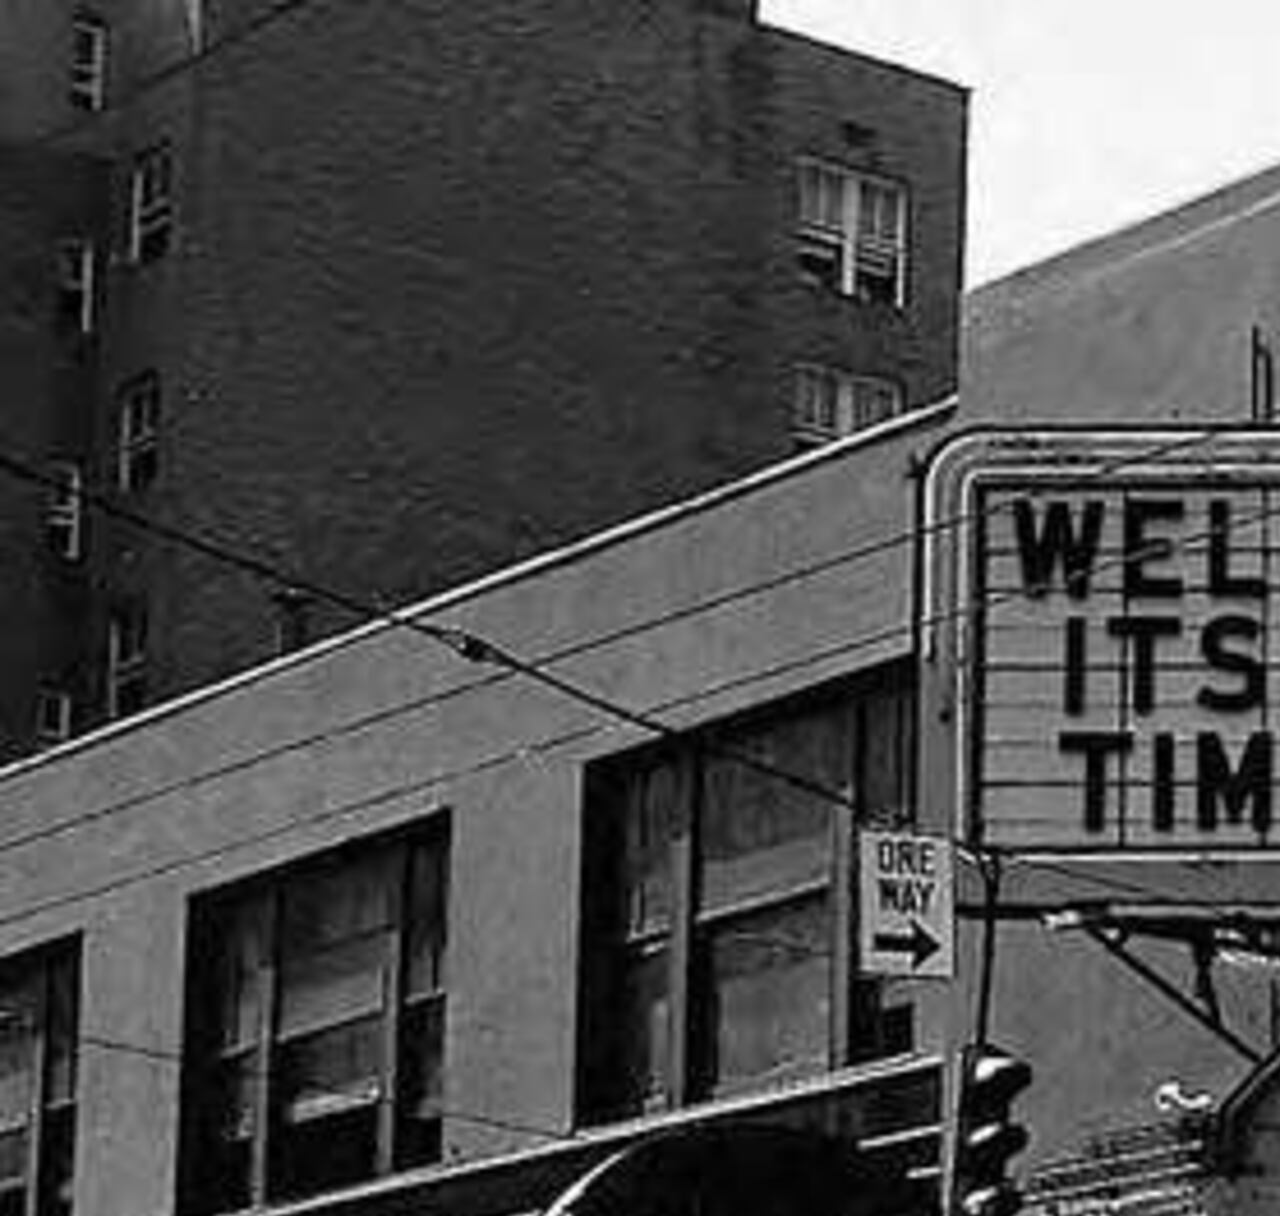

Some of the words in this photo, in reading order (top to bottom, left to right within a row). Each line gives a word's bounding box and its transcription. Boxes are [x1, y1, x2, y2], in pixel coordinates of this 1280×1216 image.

[1063, 615, 1267, 716] ITS
[877, 841, 936, 875] ONE
[877, 877, 938, 916] WAY
